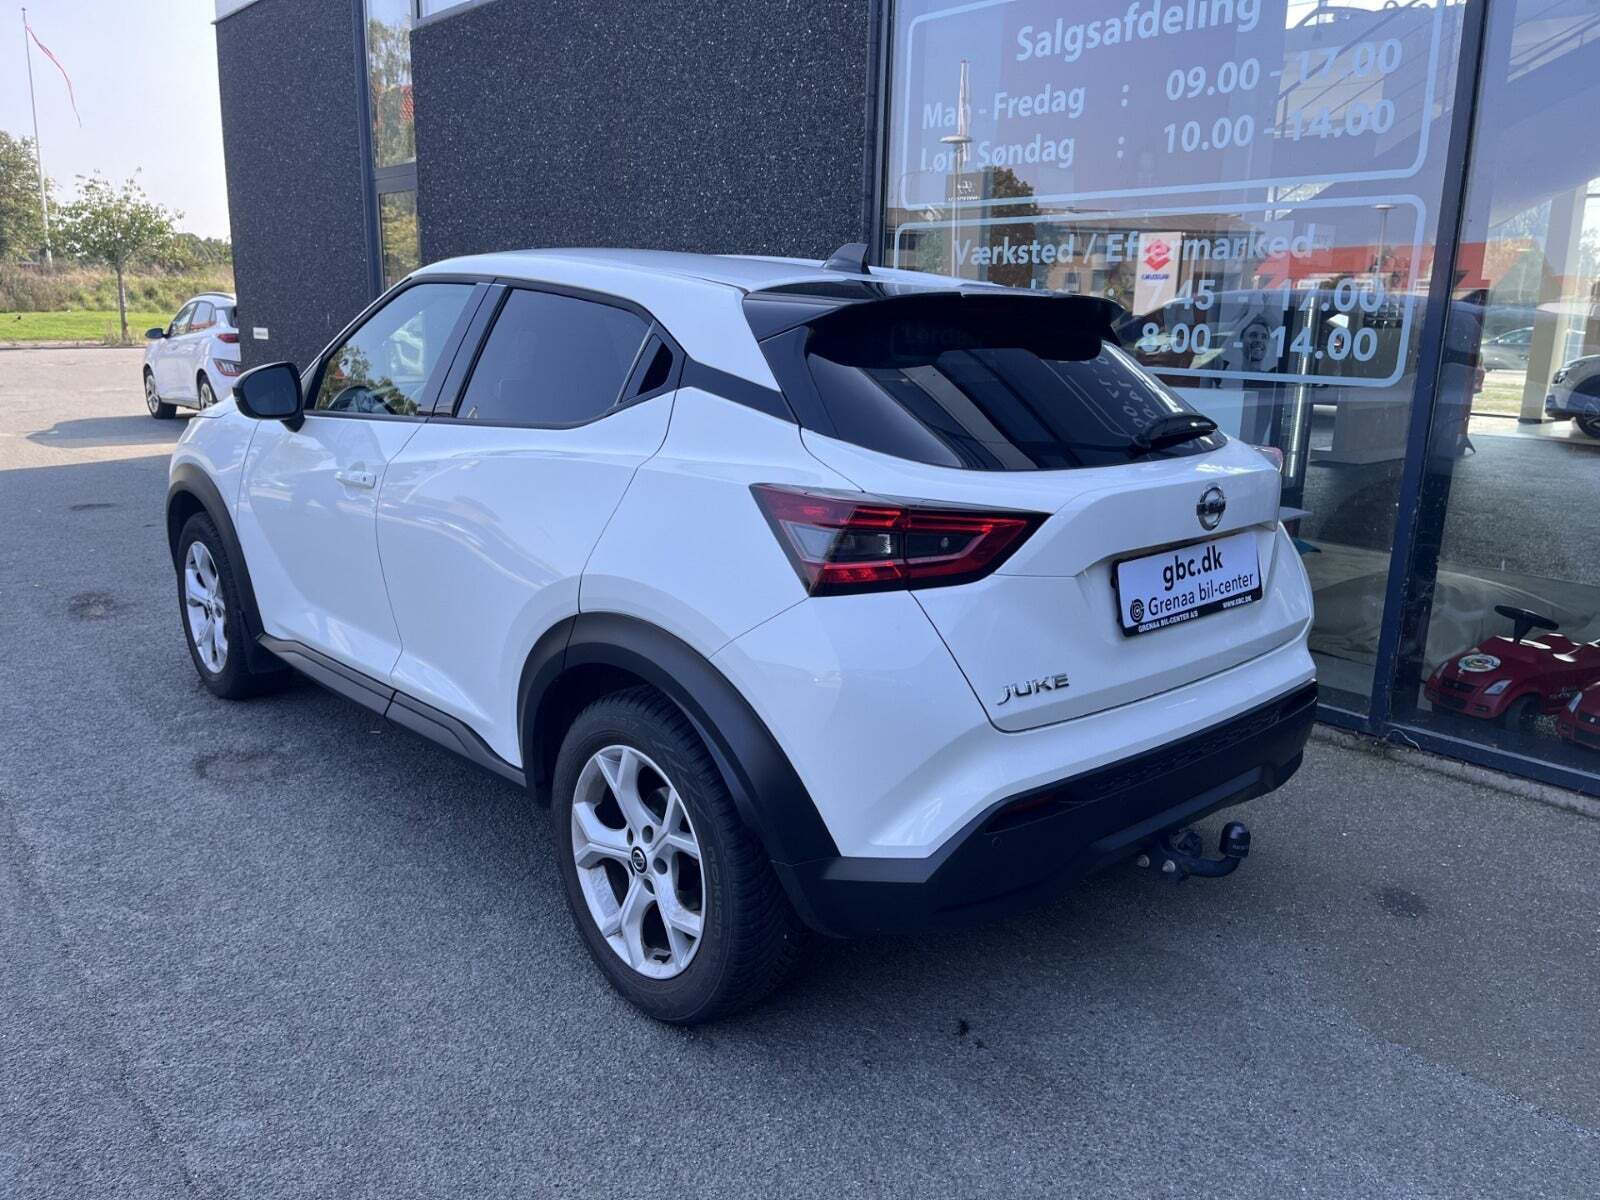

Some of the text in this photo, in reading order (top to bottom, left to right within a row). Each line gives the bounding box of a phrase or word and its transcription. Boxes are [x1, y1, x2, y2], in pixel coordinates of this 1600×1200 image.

[1016, 0, 1261, 62] Salgsafdeling
[993, 84, 1086, 119] Fredag
[1166, 57, 1261, 101] 09.00
[1297, 38, 1403, 82] 17.00
[977, 133, 1076, 170] Søndag
[1163, 114, 1256, 153] 10.00
[1291, 98, 1396, 141] 14.00
[955, 233, 1075, 266] Værksted
[1269, 326, 1378, 361] 14.00
[1163, 545, 1224, 591] gbc.dk
[1148, 573, 1254, 616] Grenaa bil-center
[997, 673, 1070, 706] JUKE
